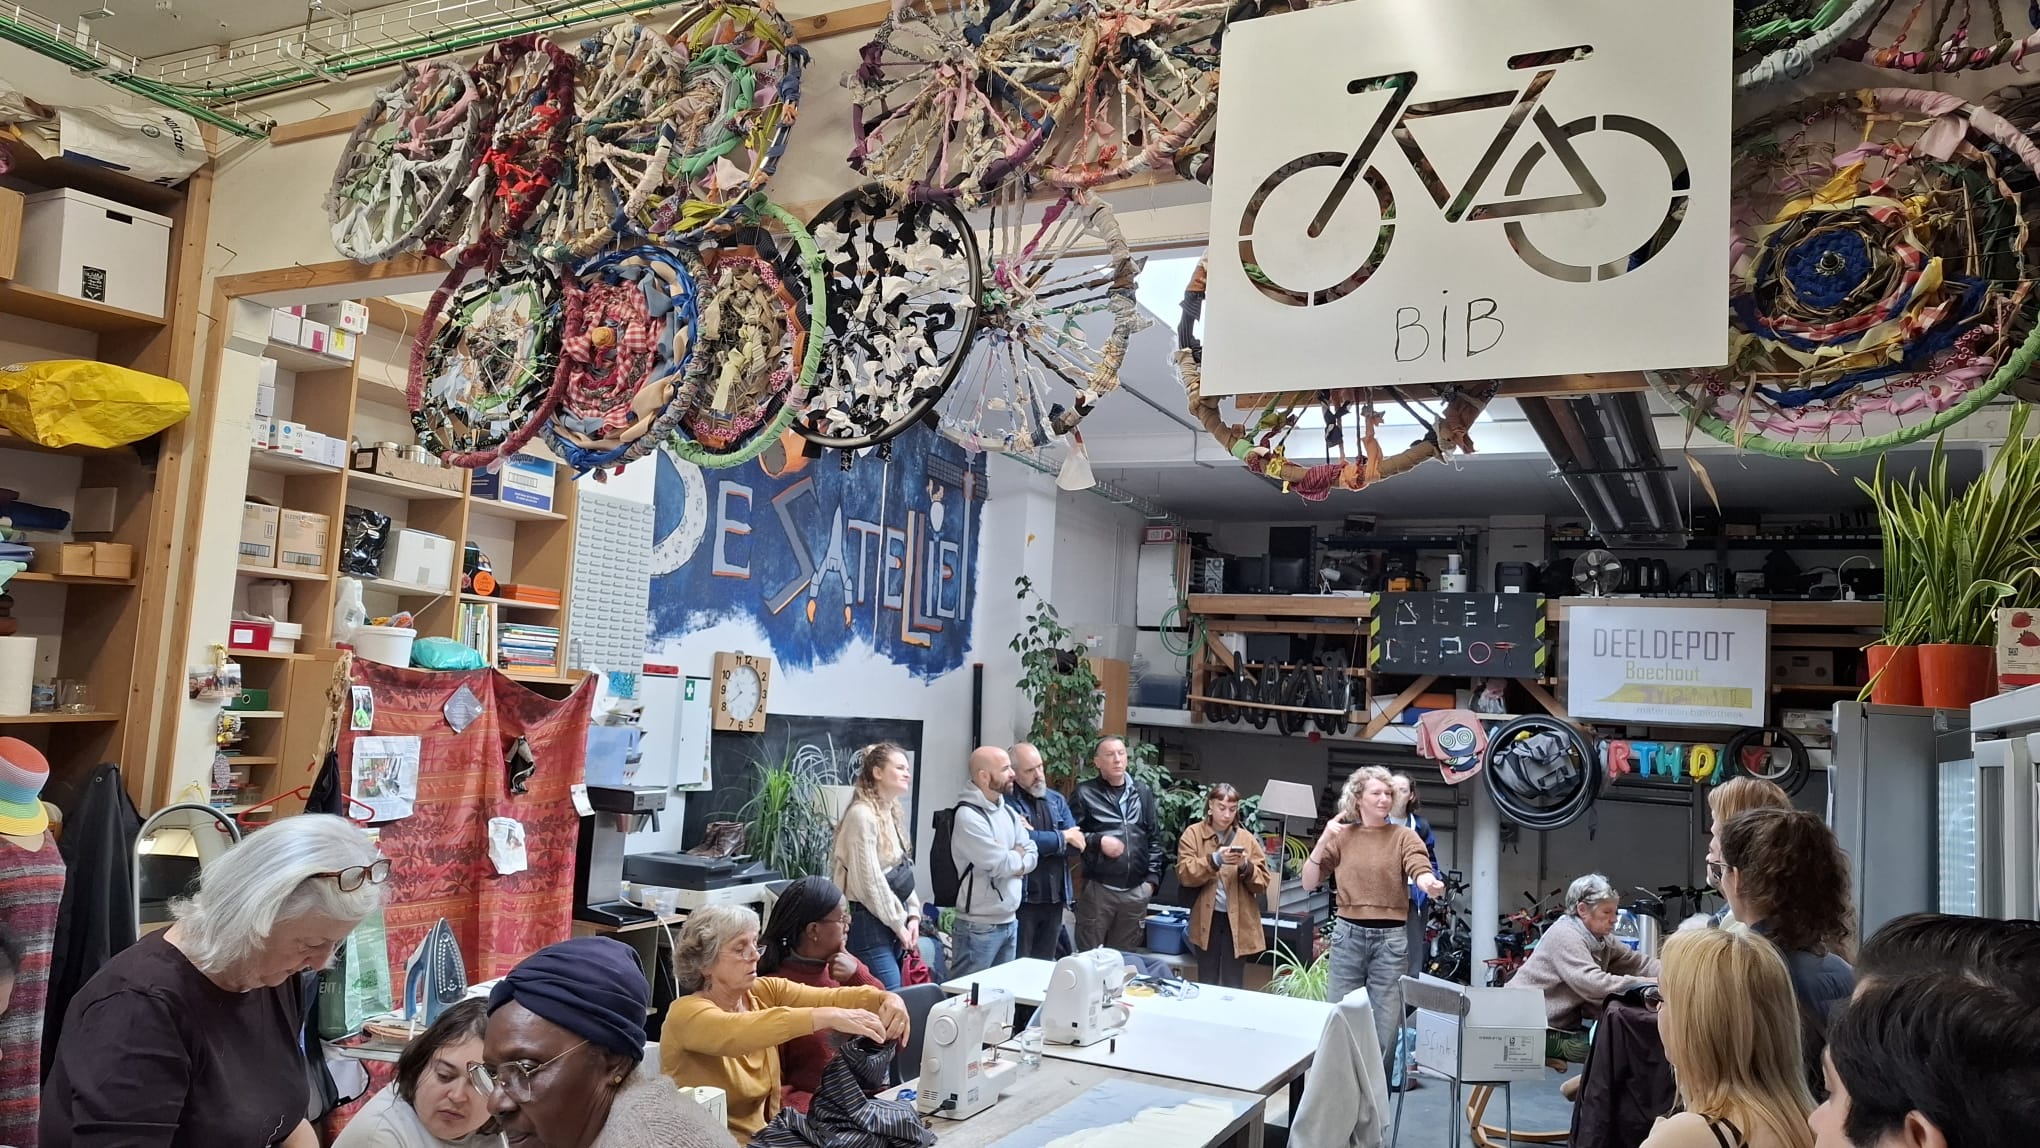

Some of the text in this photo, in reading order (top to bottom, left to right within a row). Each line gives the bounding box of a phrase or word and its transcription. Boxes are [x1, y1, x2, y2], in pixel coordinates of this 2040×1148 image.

[1395, 595, 1510, 627] DEEL
[1593, 628, 1735, 661] DEELDEPOT
[736, 655, 742, 665] 11
[745, 655, 752, 665] 12
[755, 660, 759, 669] 1
[722, 670, 731, 680] 10
[1625, 660, 1700, 681] Boechout
[761, 672, 767, 682] 2
[720, 685, 727, 695] 9
[761, 690, 768, 699] 3
[720, 702, 727, 712] 8
[757, 704, 763, 713] 4
[728, 717, 735, 727] 7
[738, 721, 744, 731] 6
[748, 718, 754, 728] 5
